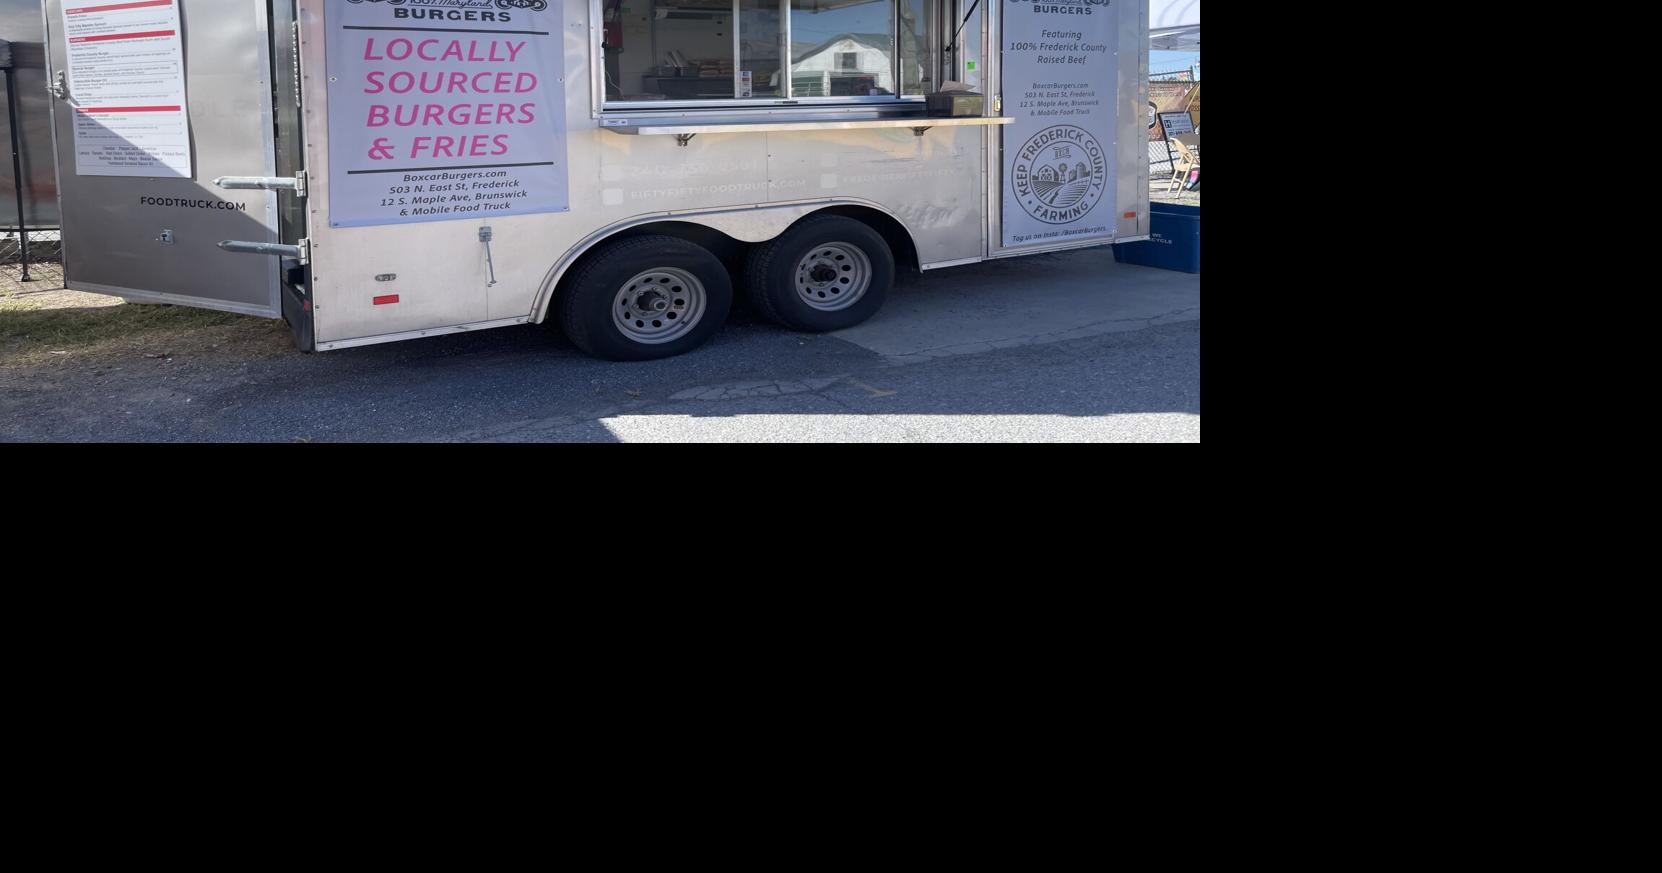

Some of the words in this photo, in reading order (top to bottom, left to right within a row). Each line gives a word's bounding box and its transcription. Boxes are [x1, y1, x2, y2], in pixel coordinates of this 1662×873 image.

[394, 8, 511, 22] BURGERS
[1034, 5, 1092, 15] BURGERS
[1041, 30, 1082, 39] Featuring
[363, 38, 527, 62] LOCALLY
[1010, 42, 1037, 51] 100%
[1040, 42, 1078, 52] Frederick
[1081, 43, 1107, 54] County
[1037, 55, 1065, 64] Raised
[1068, 55, 1087, 65] Beef
[364, 71, 538, 94] SOURCED
[366, 102, 536, 128] BURGERS
[367, 137, 395, 160] &
[410, 134, 509, 159] FRIES
[1022, 127, 1084, 160] FREDERICK
[1085, 140, 1102, 191] COUNTY
[403, 171, 507, 182] BoxcarBurgers.com
[1018, 164, 1029, 197] KEEP
[390, 186, 410, 194] 503
[429, 183, 453, 192] East
[454, 182, 469, 192] St,
[472, 179, 520, 190] Frederick
[140, 196, 246, 211] FOODTRUCK.COM
[381, 198, 395, 207] 12
[412, 195, 446, 206] Maple
[450, 194, 471, 203] Ave,
[475, 190, 527, 201] Brunswick
[412, 205, 450, 216] Mobile
[454, 203, 480, 213] Food
[483, 201, 510, 211] Truck
[1032, 201, 1089, 220] FARMING
